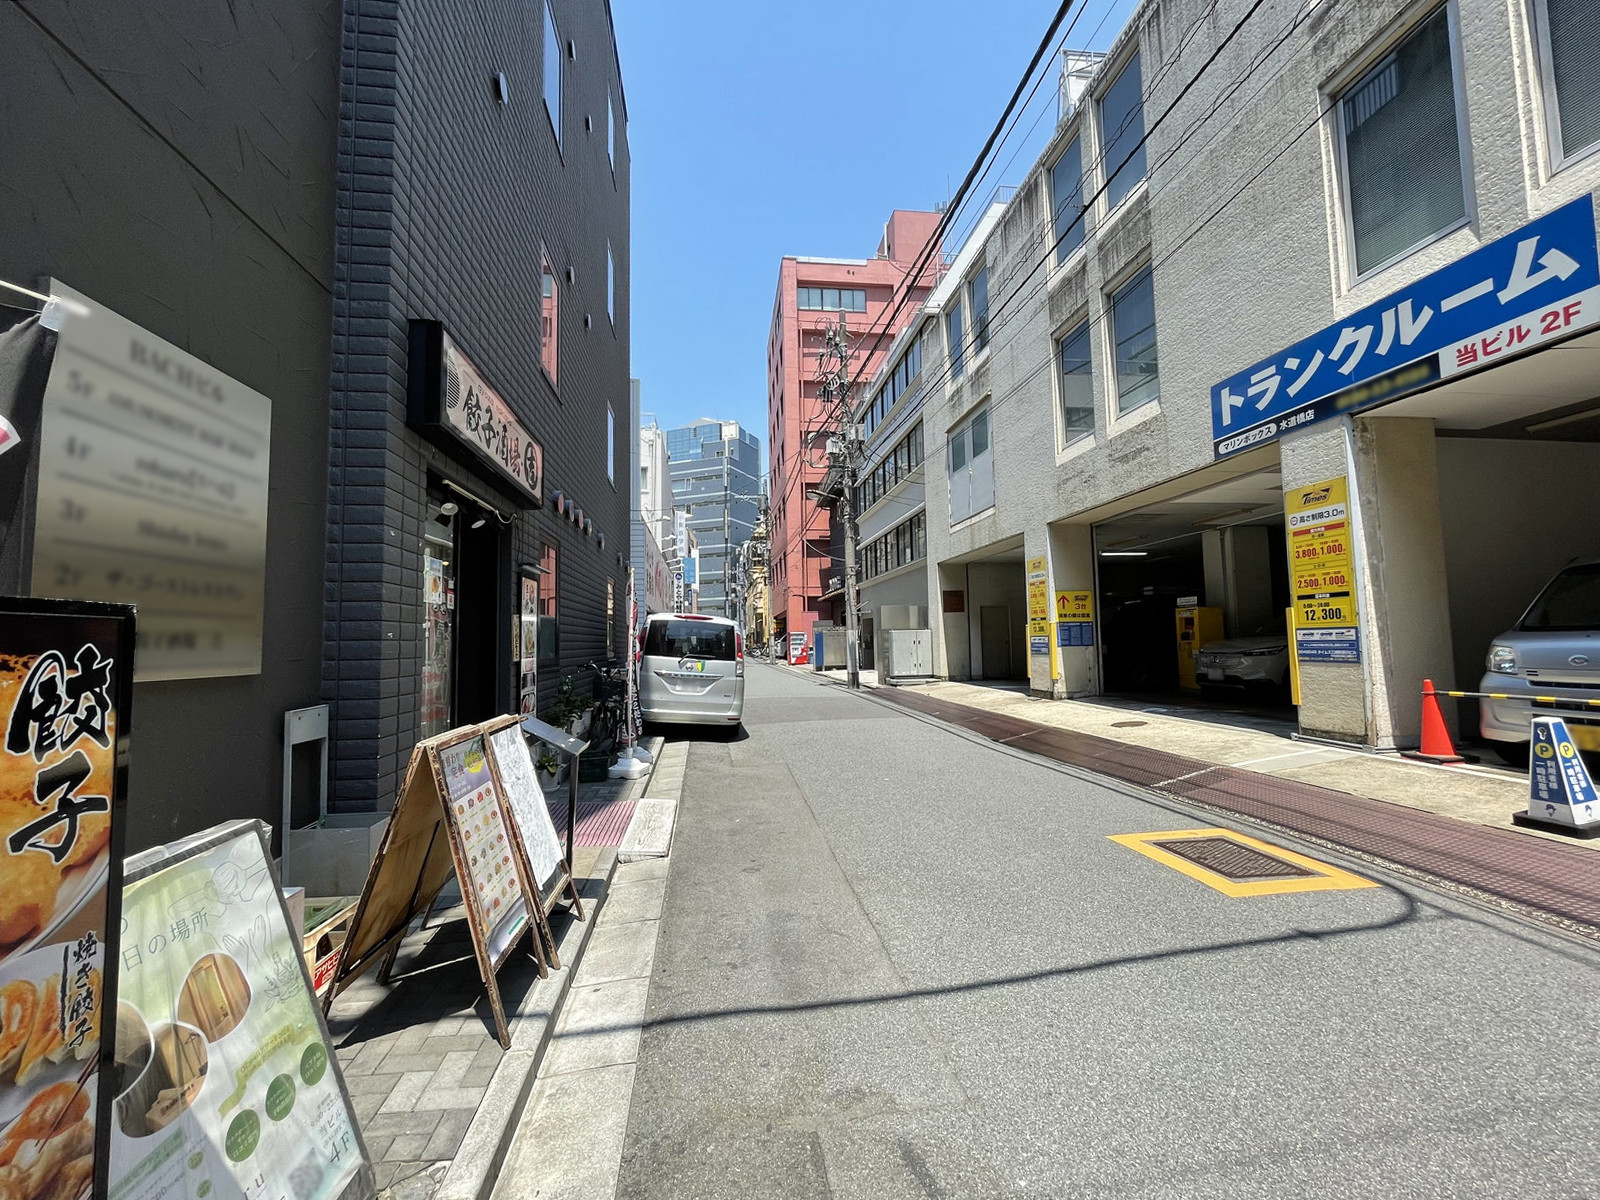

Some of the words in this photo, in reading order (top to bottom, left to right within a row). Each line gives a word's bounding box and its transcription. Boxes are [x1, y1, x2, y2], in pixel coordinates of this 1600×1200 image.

[1220, 235, 1581, 428] トランクルーム
[1456, 321, 1532, 368] 当ビル
[1540, 300, 1583, 337] 2F
[463, 384, 521, 478] 餃子酒場
[1222, 424, 1274, 452] マリンボックス
[1278, 408, 1316, 431] 水道橋店
[1302, 486, 1331, 506] Times
[5, 643, 114, 864] 餃子
[68, 929, 98, 1048] 焼き餃子
[330, 1130, 350, 1163] 4F
